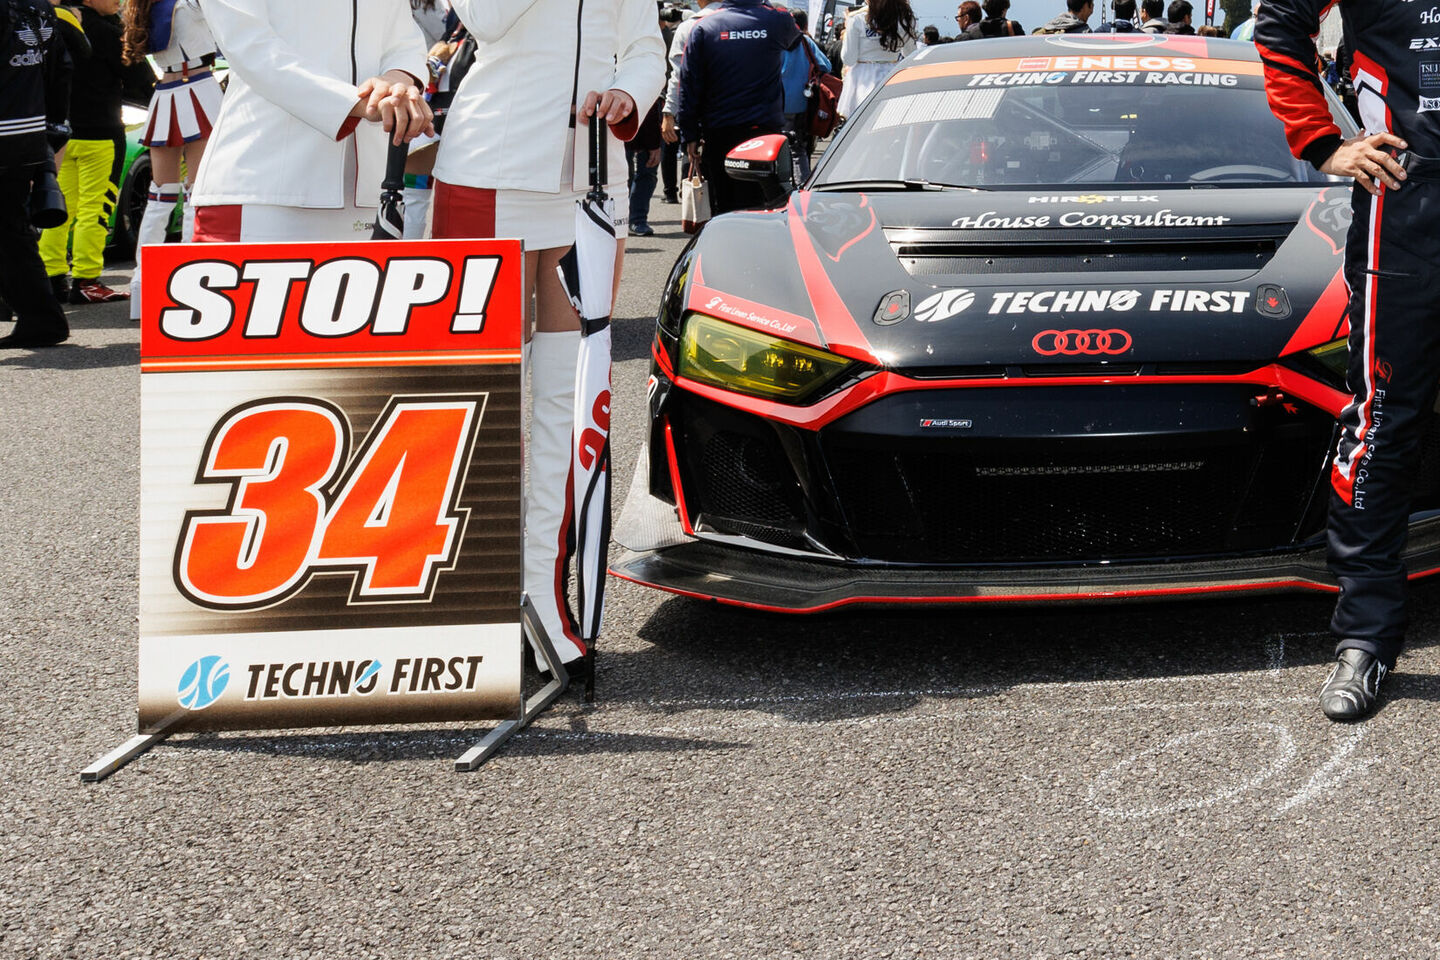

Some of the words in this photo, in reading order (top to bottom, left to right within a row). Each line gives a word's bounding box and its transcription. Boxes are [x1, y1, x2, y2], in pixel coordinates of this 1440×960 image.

[728, 30, 768, 40] ENEOS
[1054, 56, 1197, 71] ENEOS
[1071, 70, 1141, 84] FIRST
[1145, 72, 1239, 86] RACING
[951, 211, 1050, 229] House
[1059, 209, 1231, 227] Consultant
[158, 254, 503, 340] STOP!
[1149, 289, 1251, 314] FIRST
[949, 420, 969, 428] Sport
[172, 392, 489, 612] 34
[388, 654, 484, 696] FIRST
